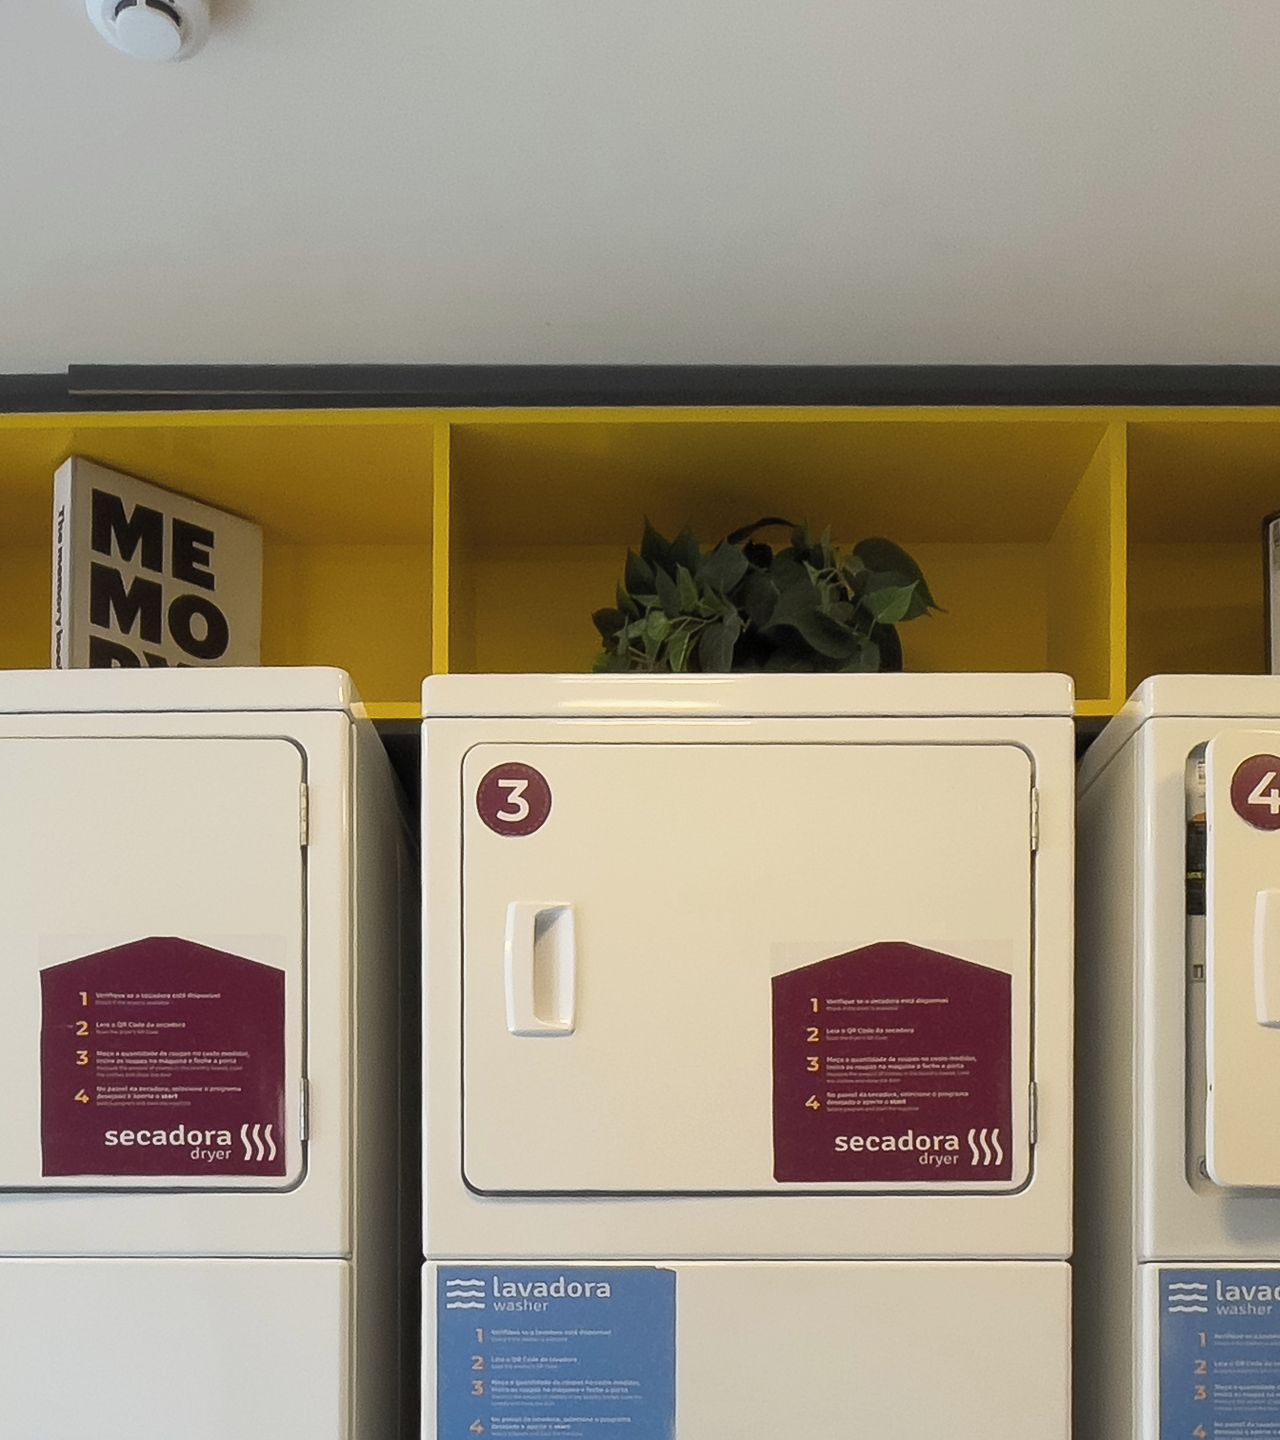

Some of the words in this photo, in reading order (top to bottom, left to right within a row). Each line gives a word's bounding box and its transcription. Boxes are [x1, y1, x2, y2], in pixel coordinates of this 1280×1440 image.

[91, 488, 215, 592] ME
[90, 561, 229, 661] MO
[496, 780, 530, 823] 3
[79, 991, 88, 1006] 1
[810, 998, 819, 1013] 1
[75, 1021, 89, 1036] 2
[806, 1027, 819, 1042] 2
[76, 1050, 89, 1065] 3
[806, 1056, 819, 1071] 3
[74, 1089, 89, 1104] 4
[805, 1095, 820, 1110] 4
[104, 1125, 232, 1146] secadora
[834, 1130, 960, 1151] secadora
[190, 1147, 232, 1162] dryer
[918, 1153, 959, 1167] dryer
[493, 1276, 611, 1298] lavadora
[493, 1299, 549, 1312] washer
[1216, 1303, 1272, 1316] washer
[475, 1328, 484, 1343] 1
[1198, 1333, 1207, 1347] 1
[471, 1356, 484, 1370] 2
[1194, 1360, 1207, 1375] 2
[471, 1381, 484, 1396] 3
[1194, 1386, 1207, 1400] 3
[470, 1420, 484, 1434] 4
[1192, 1425, 1207, 1439] 4
